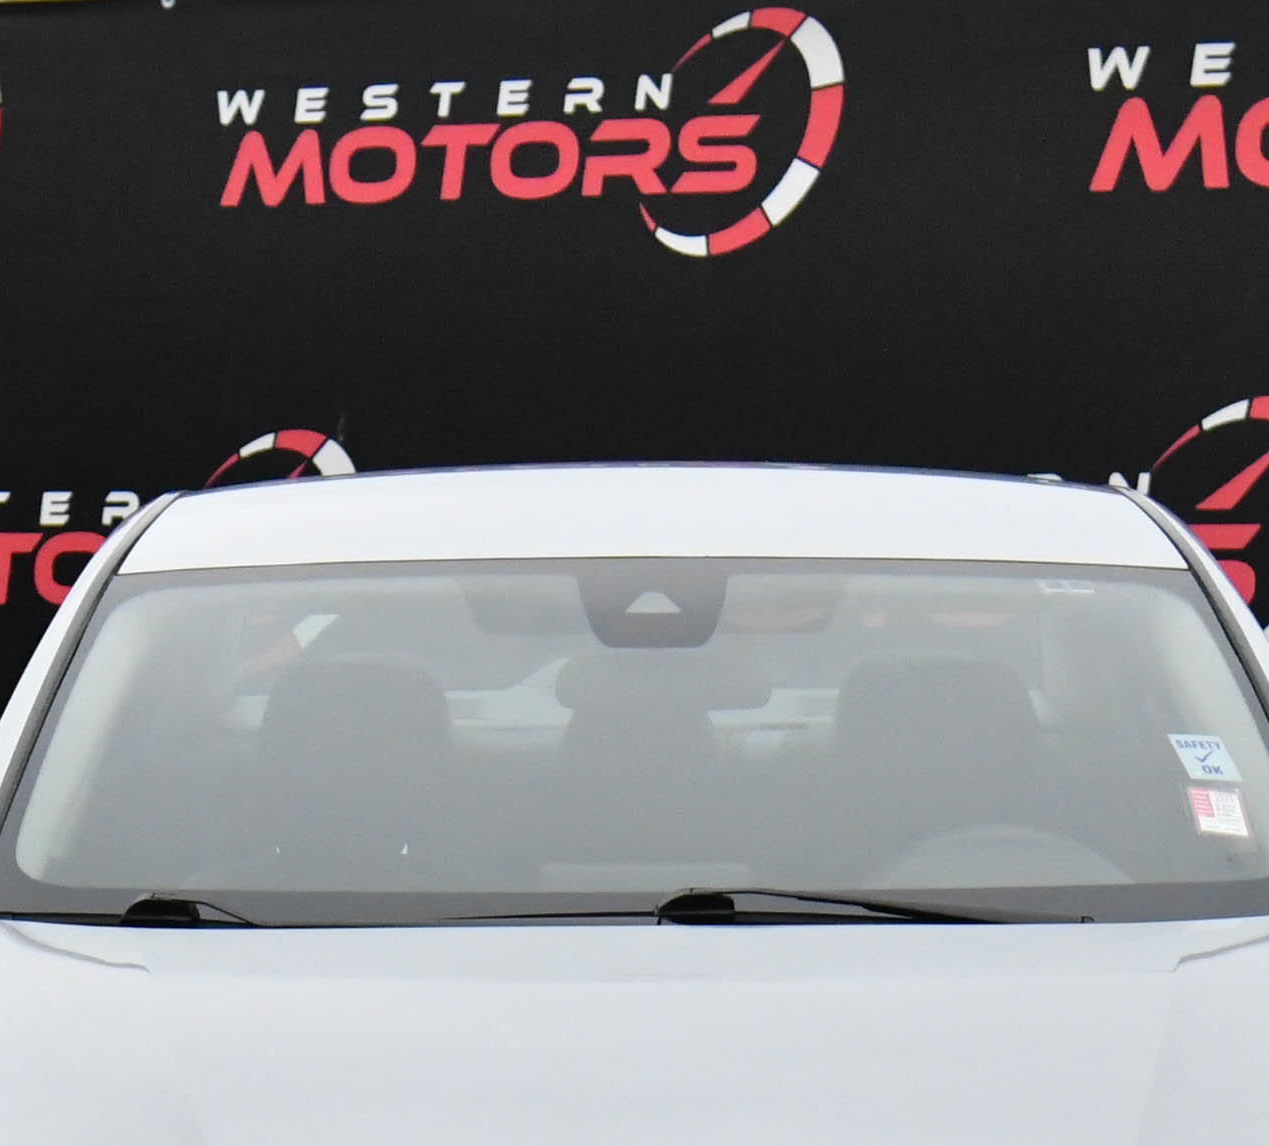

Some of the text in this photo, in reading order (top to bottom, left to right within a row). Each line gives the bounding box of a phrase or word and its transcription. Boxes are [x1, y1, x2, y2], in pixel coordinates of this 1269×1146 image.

[217, 73, 673, 126] WESTERN
[220, 114, 760, 207] MOTORS
[1175, 739, 1221, 750] SAFETY
[1202, 764, 1224, 775] OK
